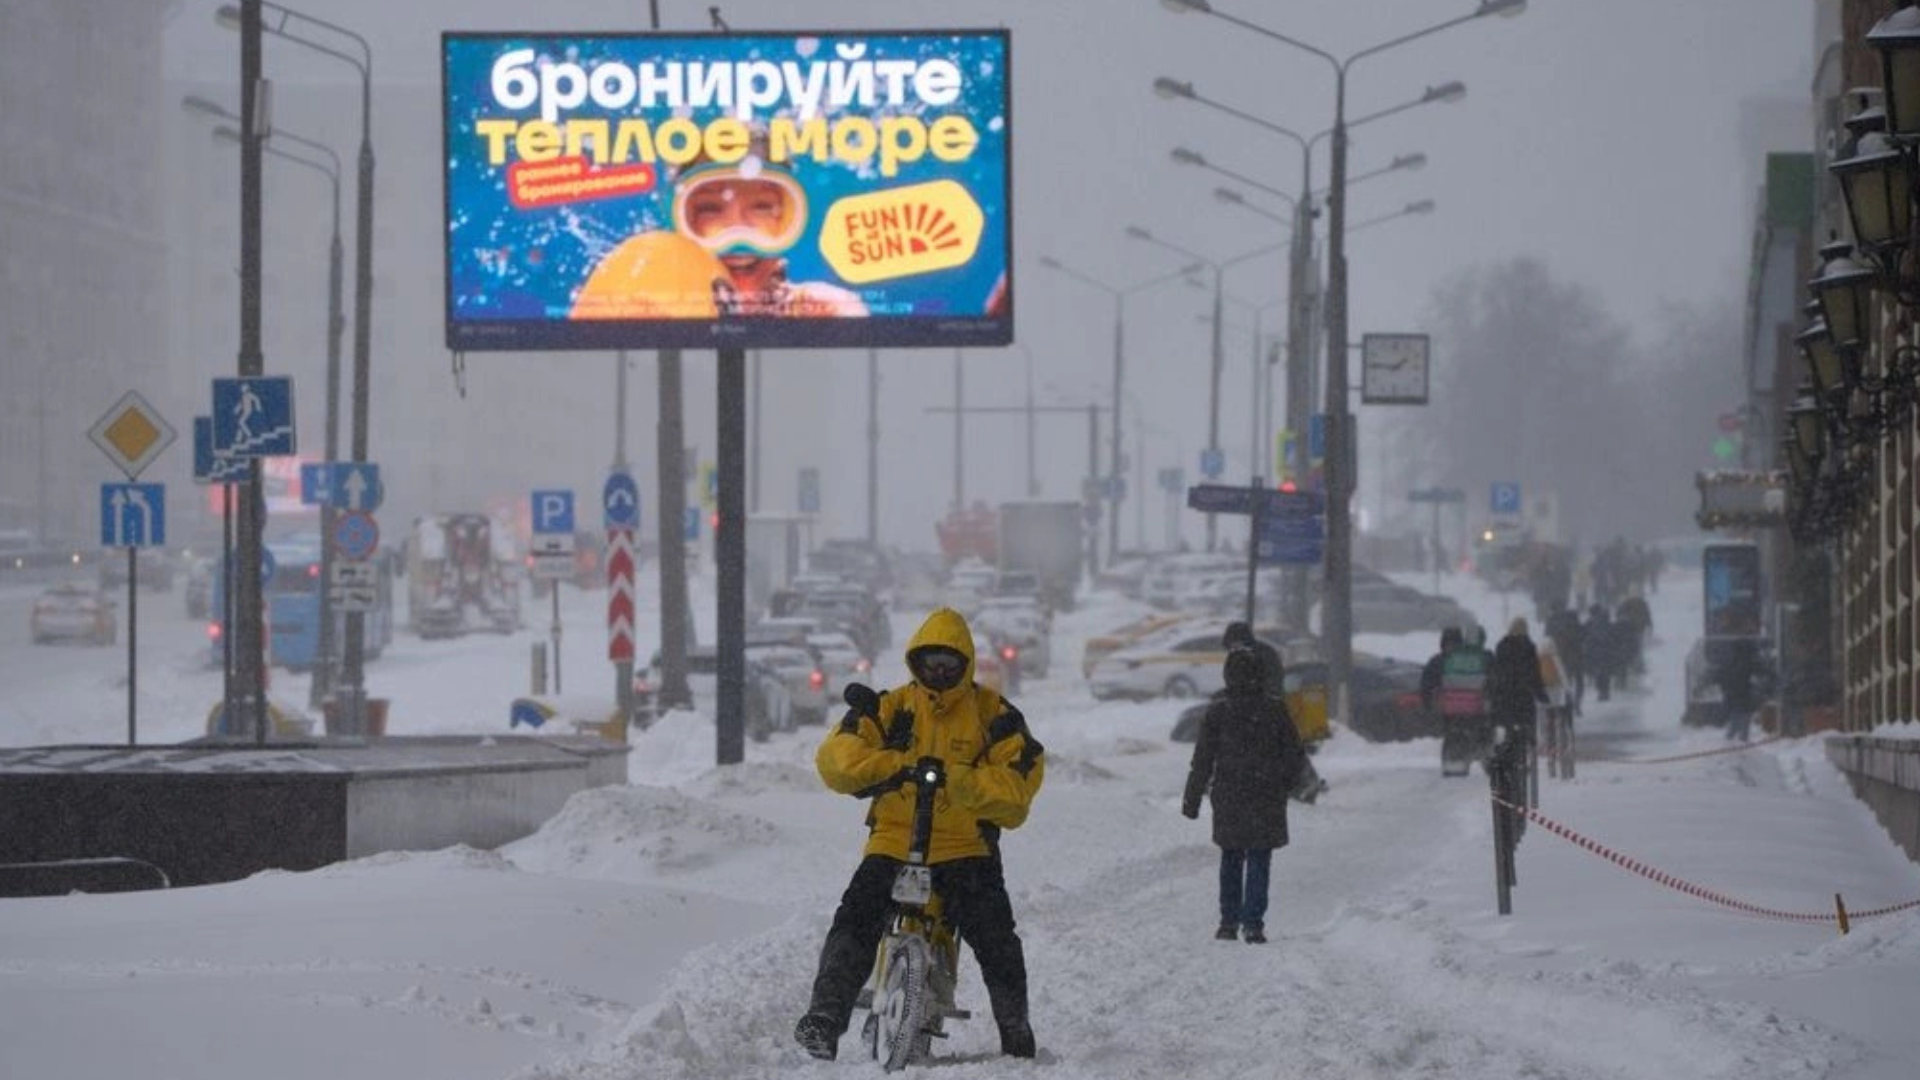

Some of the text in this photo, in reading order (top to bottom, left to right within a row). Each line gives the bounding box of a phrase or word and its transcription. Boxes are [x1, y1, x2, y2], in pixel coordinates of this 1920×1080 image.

[491, 43, 962, 121] бронируйте
[477, 115, 979, 176] теплое море
[845, 206, 899, 237] FUN
[848, 232, 904, 265] SUN
[542, 494, 565, 528] P
